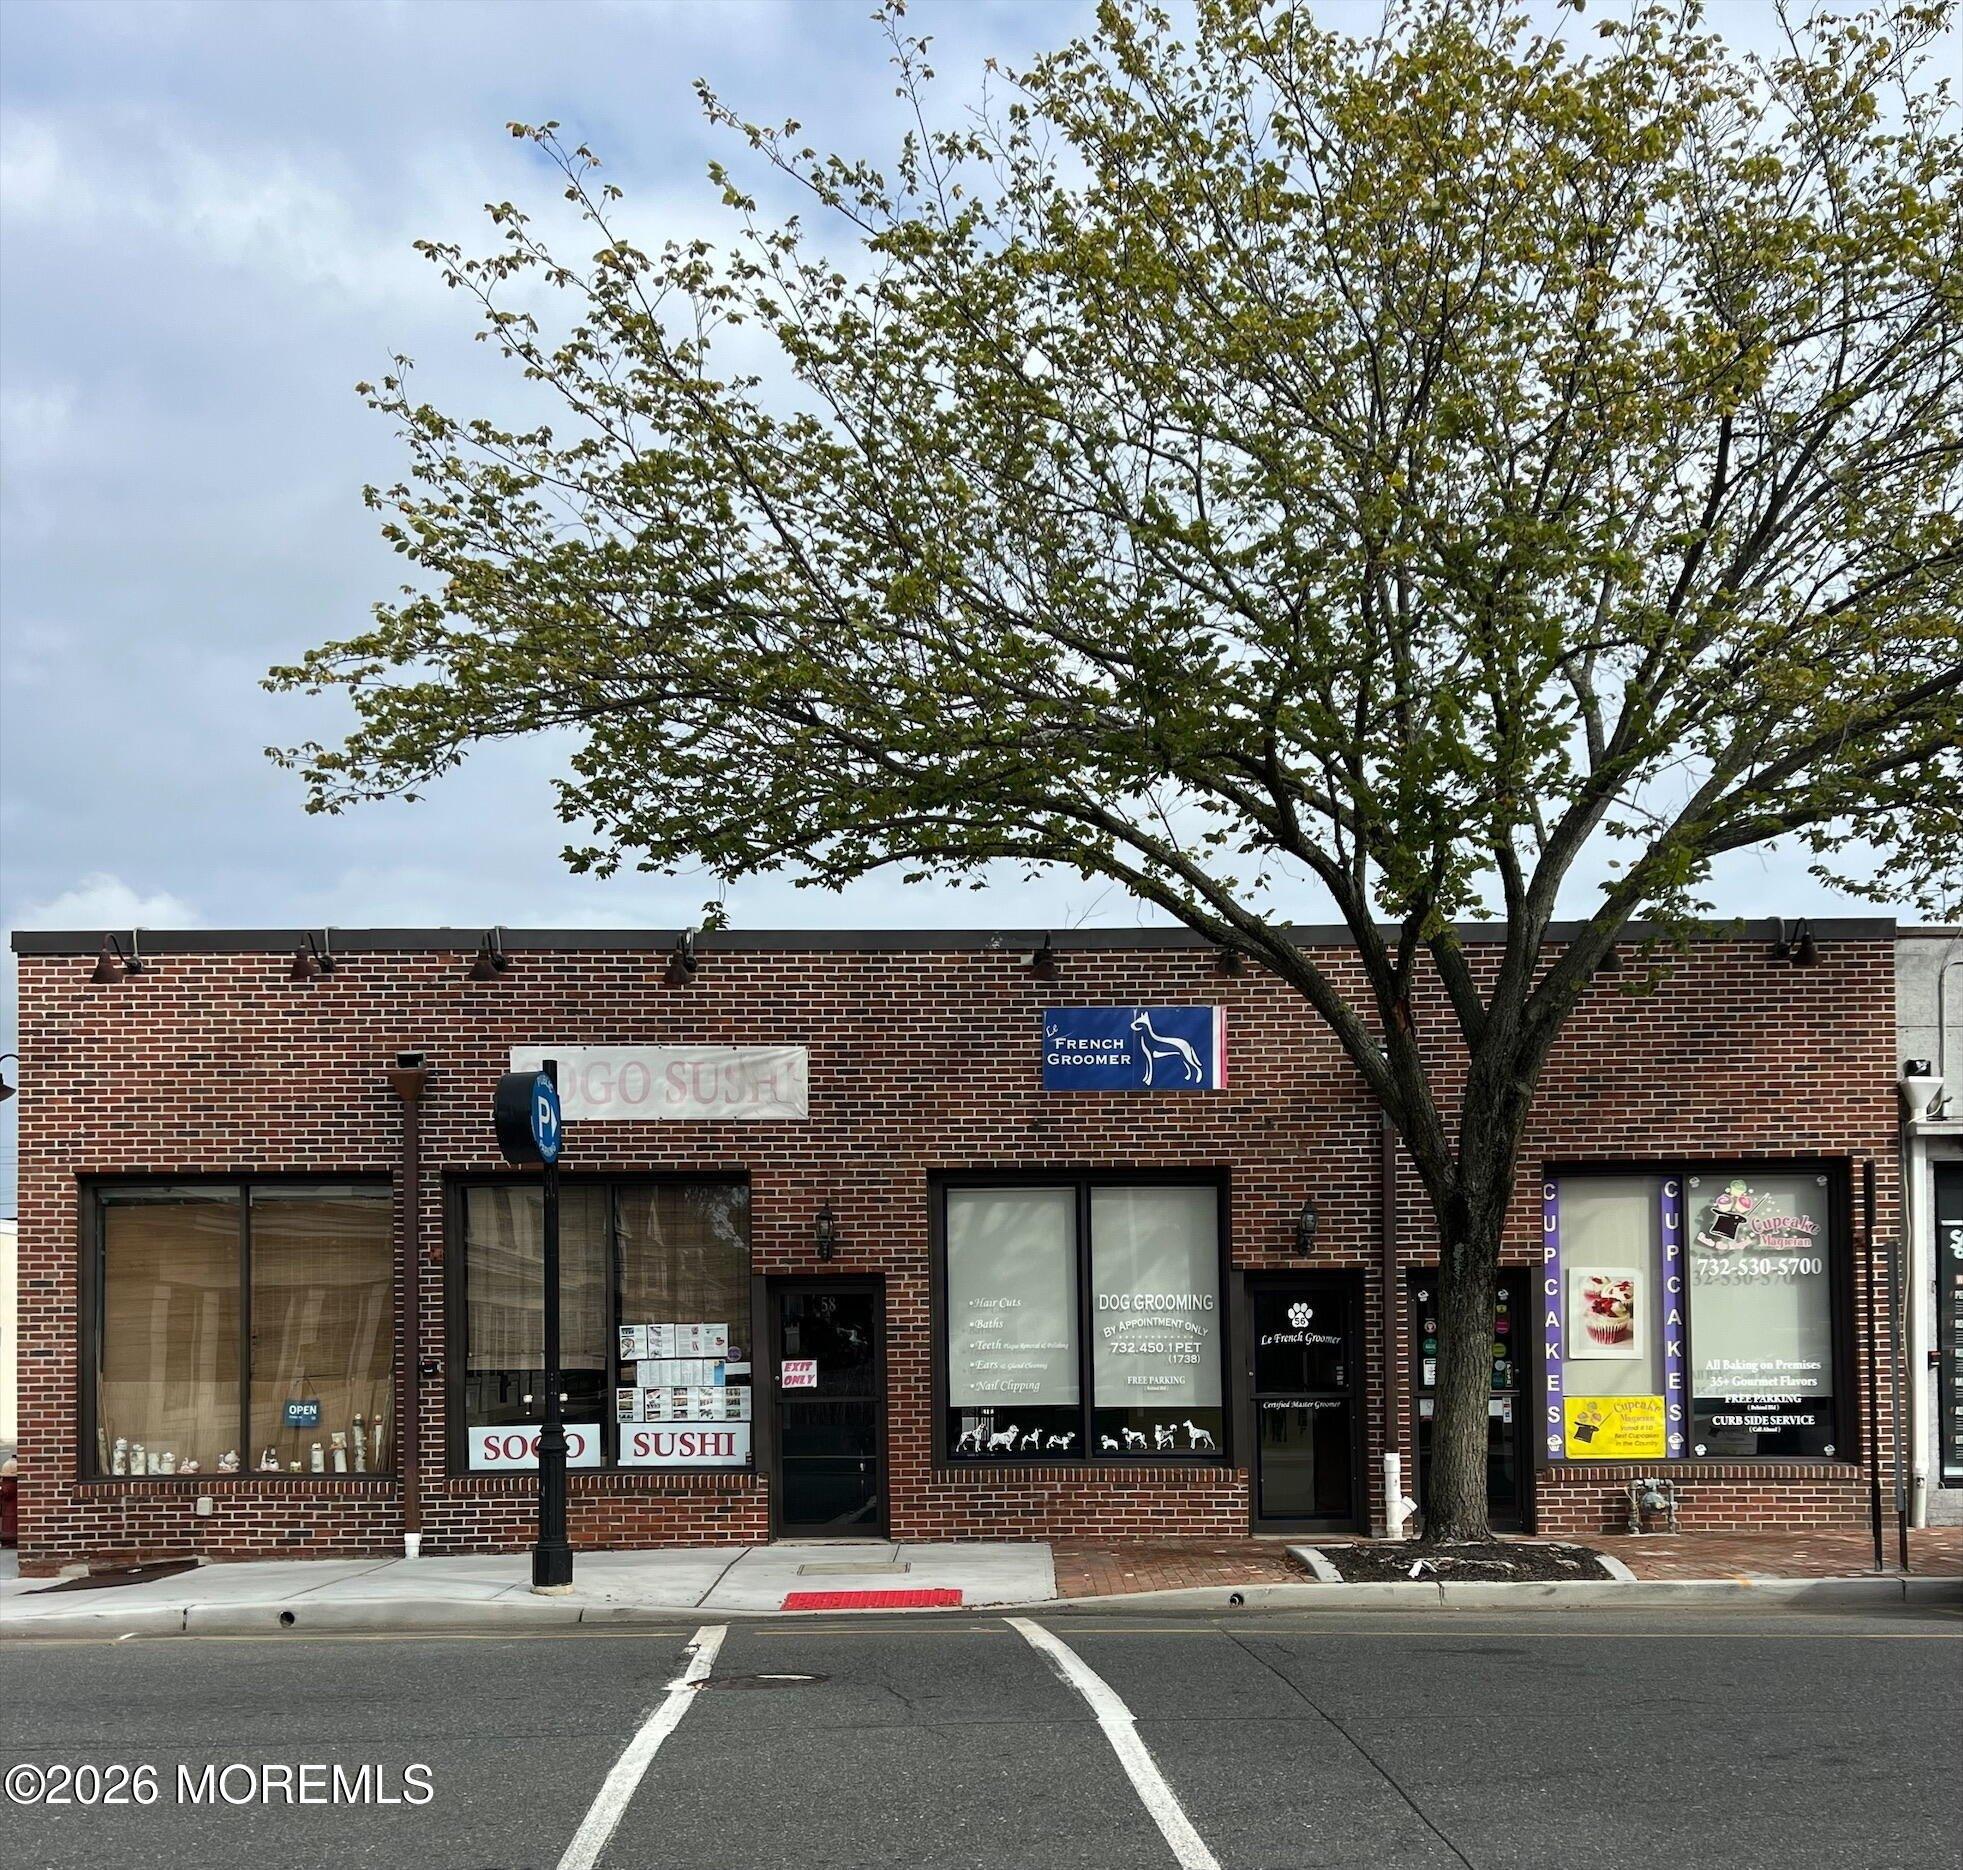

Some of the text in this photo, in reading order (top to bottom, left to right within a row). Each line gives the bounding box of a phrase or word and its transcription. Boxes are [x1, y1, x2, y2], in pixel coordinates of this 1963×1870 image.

[1045, 1023, 1059, 1037] Le
[1055, 1038, 1124, 1049] FRENCH
[1047, 1053, 1131, 1065] GROOMER
[520, 1060, 652, 1105] OGO
[538, 1096, 551, 1138] P
[1750, 1214, 1821, 1236] Cupcake
[1760, 1234, 1813, 1250] Magician
[1697, 1257, 1822, 1276] 732-530-5700
[821, 1296, 837, 1312] 58
[973, 1298, 1022, 1308] Hair Cuts
[1099, 1294, 1214, 1310] DOG GROOMING
[1543, 1184, 1561, 1424] CUPCAKES
[1663, 1180, 1682, 1421] CUPCAKES
[974, 1317, 1004, 1329] Baths
[1103, 1317, 1209, 1338] BY APPOINTMENT ONLY
[1294, 1317, 1306, 1326] 56
[975, 1339, 1002, 1350] Teeth
[1261, 1331, 1341, 1346] Le French Groomer
[975, 1360, 998, 1370] Ears
[1168, 1355, 1201, 1364] (1738)
[784, 1361, 813, 1372] EXIT
[1705, 1359, 1822, 1373] All Baking on Premises
[784, 1374, 815, 1386] ONLY
[1127, 1376, 1186, 1385] FREE PARKING
[1710, 1376, 1818, 1387] 35+ Gourmet Flavors
[975, 1380, 1041, 1393] Nail Clipping
[1725, 1393, 1802, 1404] FREE PARKING
[288, 1405, 317, 1415] OPEN
[1263, 1400, 1341, 1410] Certified Master Groomer
[1613, 1401, 1661, 1413] Cupcake
[1712, 1415, 1815, 1426] CURB SIDE SERVICE
[633, 1432, 737, 1458] SUSHI
